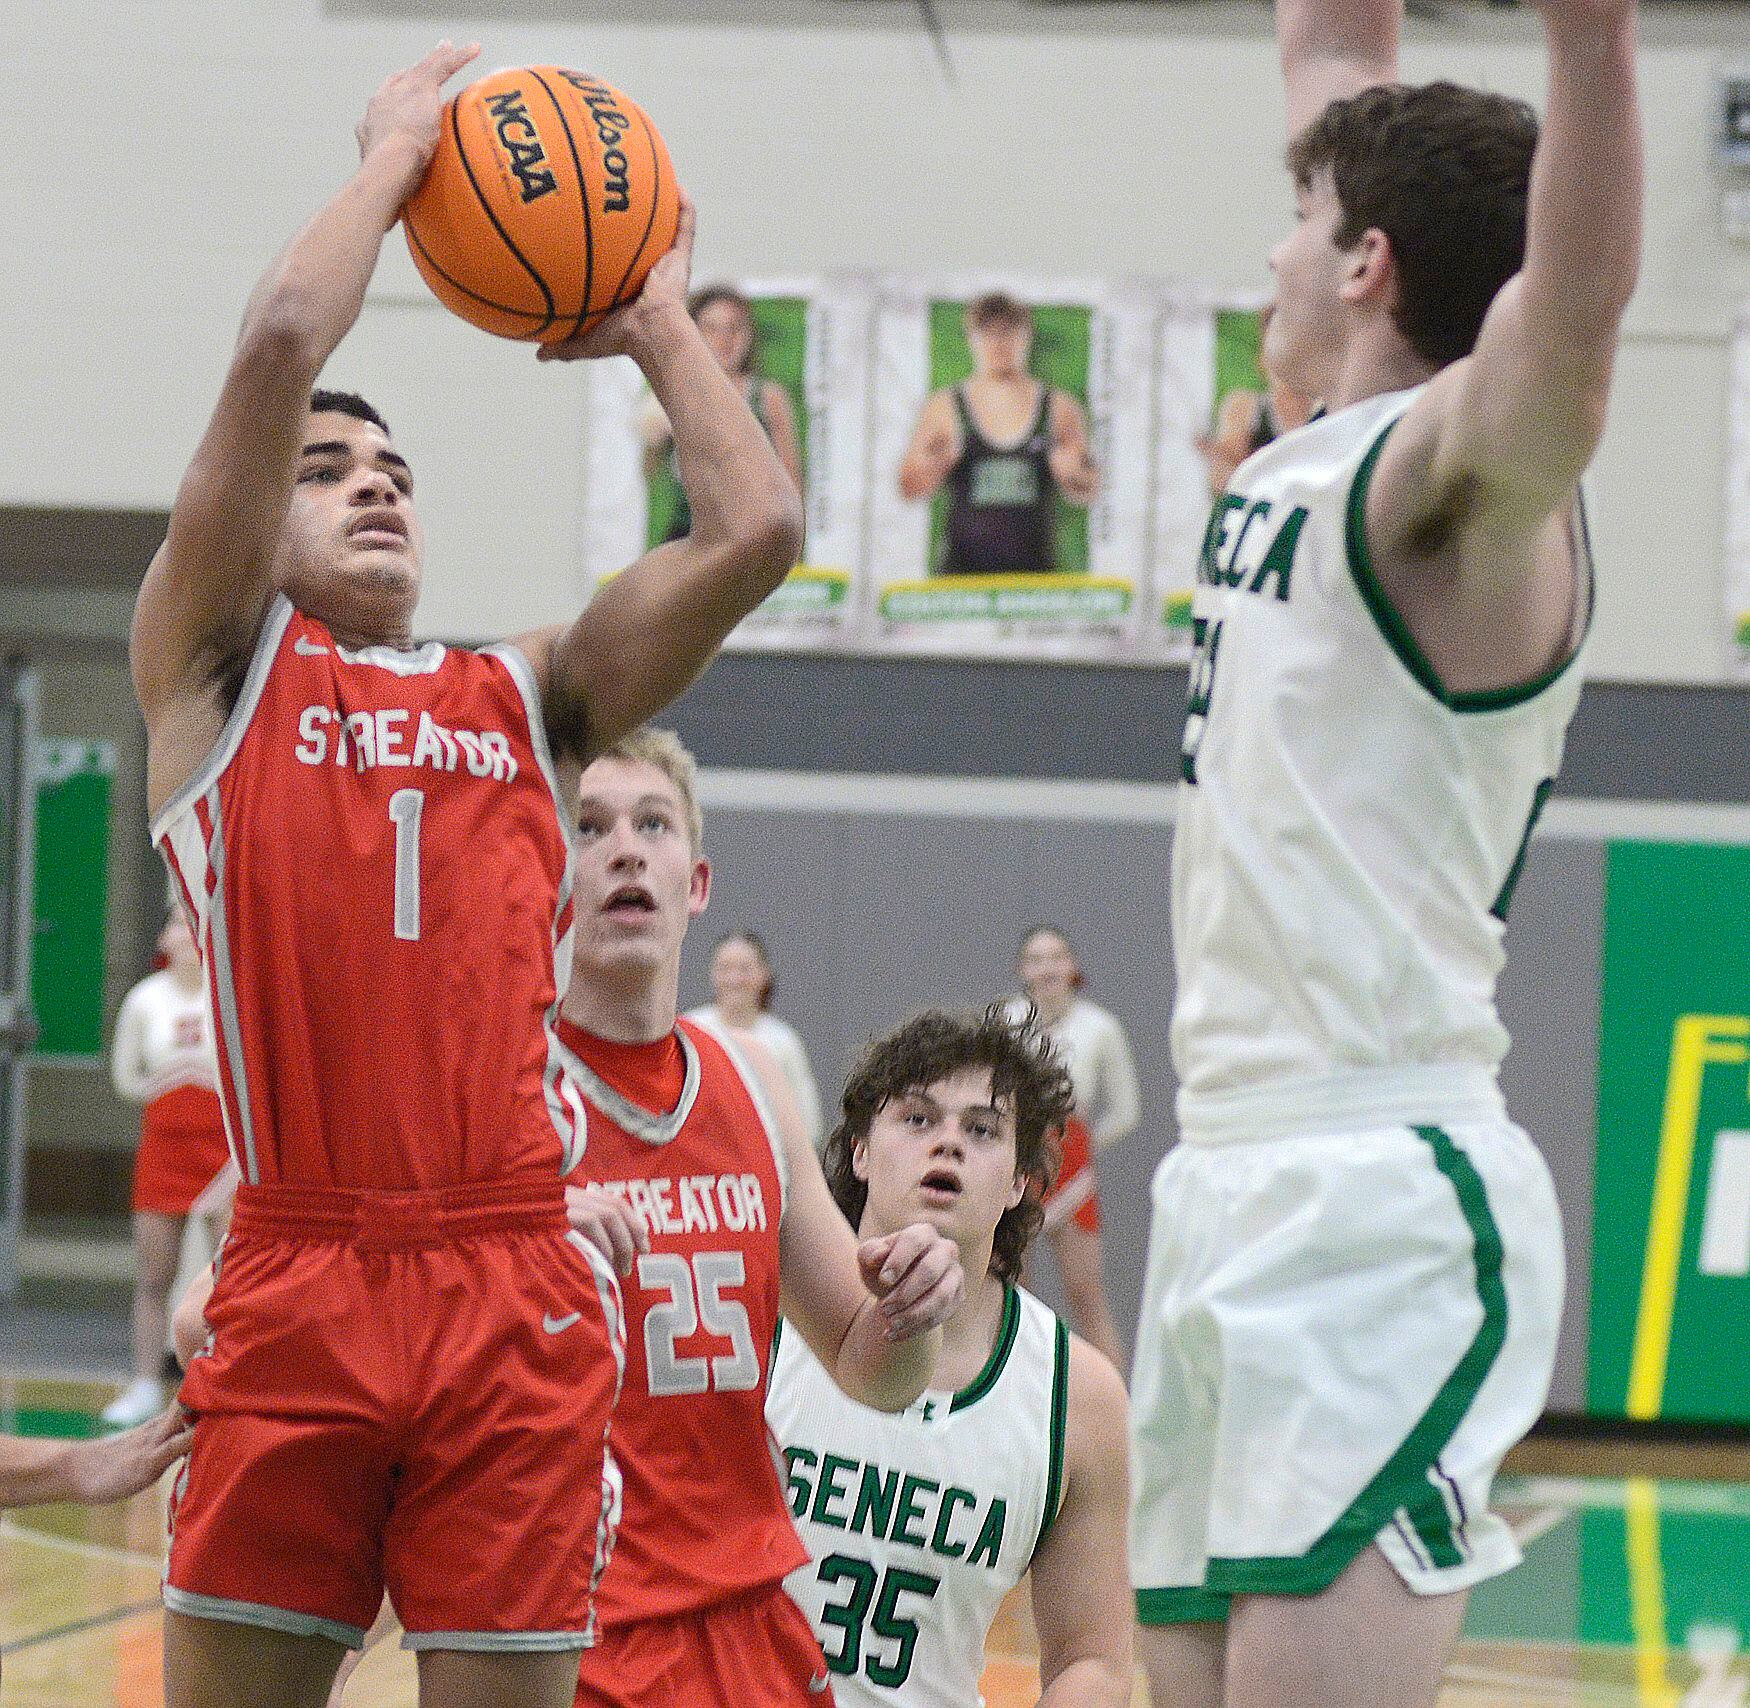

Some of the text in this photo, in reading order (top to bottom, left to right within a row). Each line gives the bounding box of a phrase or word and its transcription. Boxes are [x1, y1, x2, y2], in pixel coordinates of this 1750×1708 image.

[484, 89, 558, 204] NCAA
[294, 704, 519, 783] STREATOR
[389, 788, 425, 941] 1
[586, 1173, 767, 1235] REATOR
[637, 1251, 760, 1396] 25
[782, 1446, 1008, 1569] SENECA
[816, 1552, 942, 1690] 35
